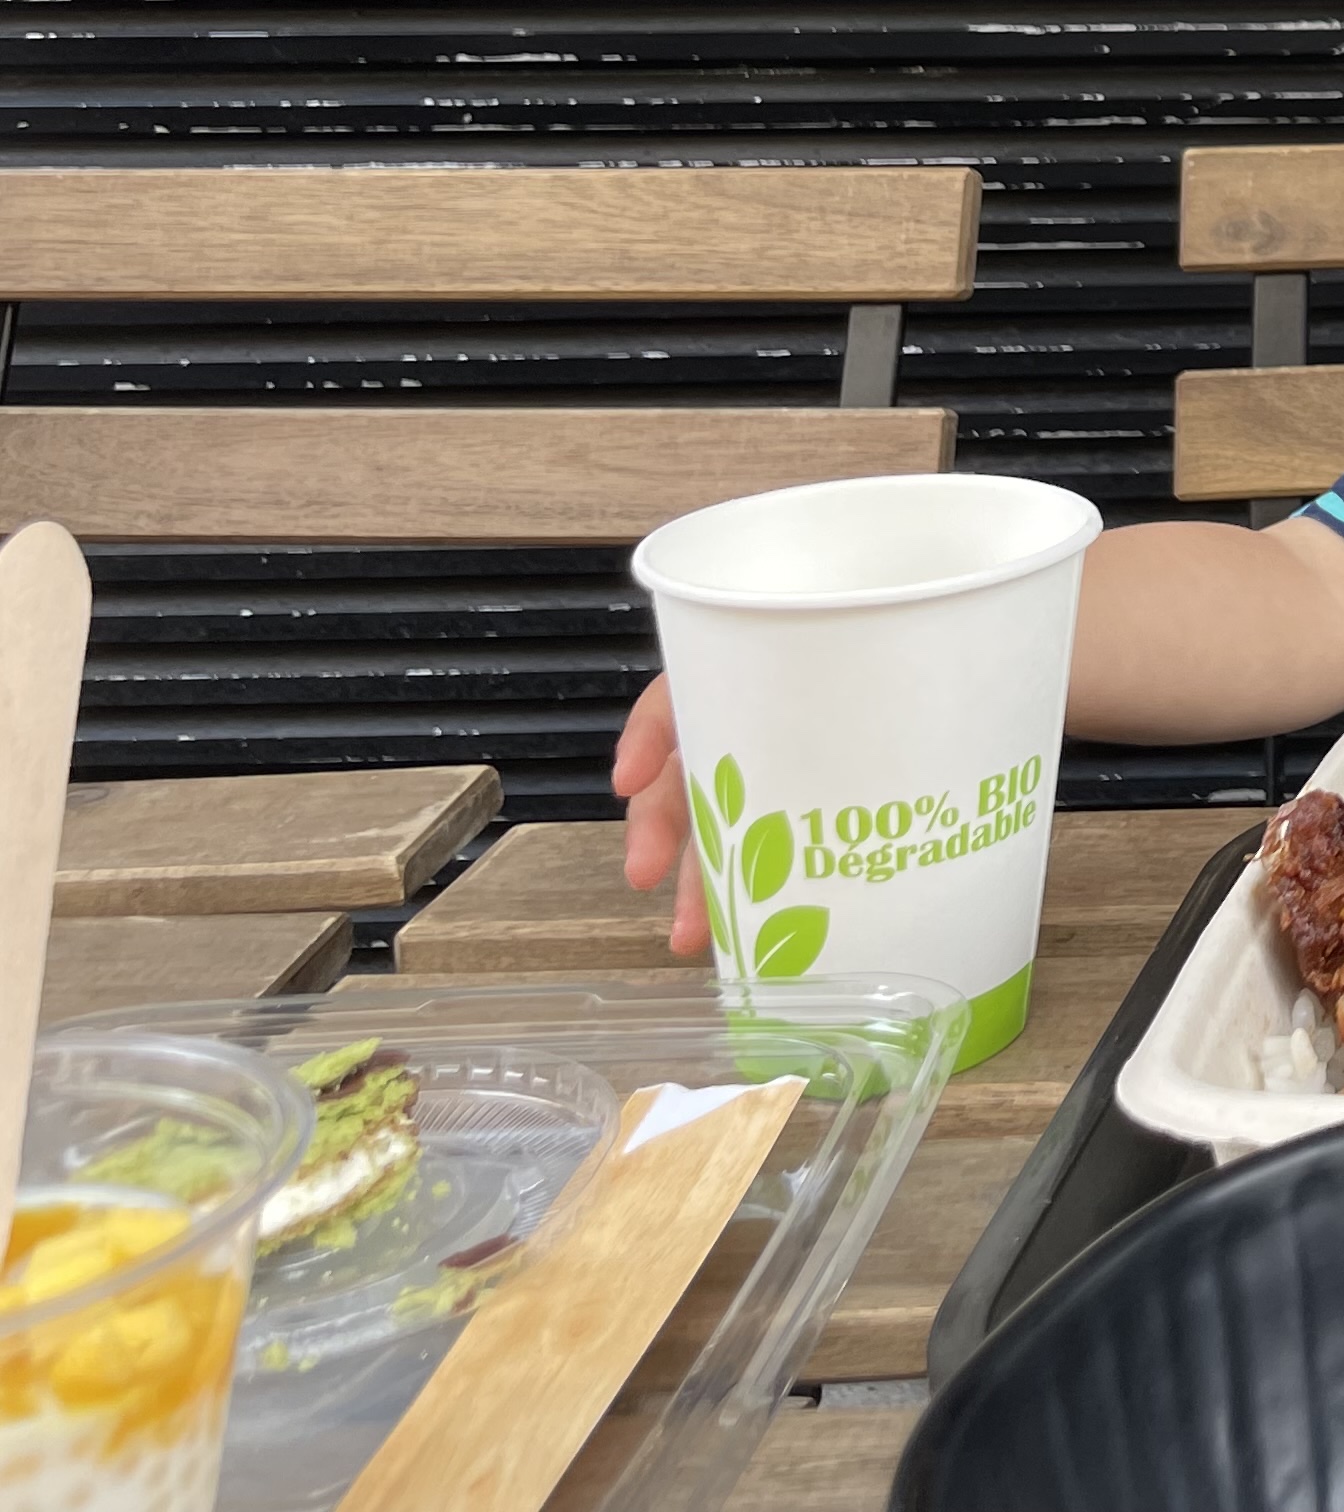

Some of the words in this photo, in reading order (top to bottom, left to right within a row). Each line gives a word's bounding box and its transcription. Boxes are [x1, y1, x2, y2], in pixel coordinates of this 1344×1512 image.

[799, 790, 960, 846] 100%
[976, 753, 1043, 818] BIO
[803, 799, 1037, 884] Dégradable
